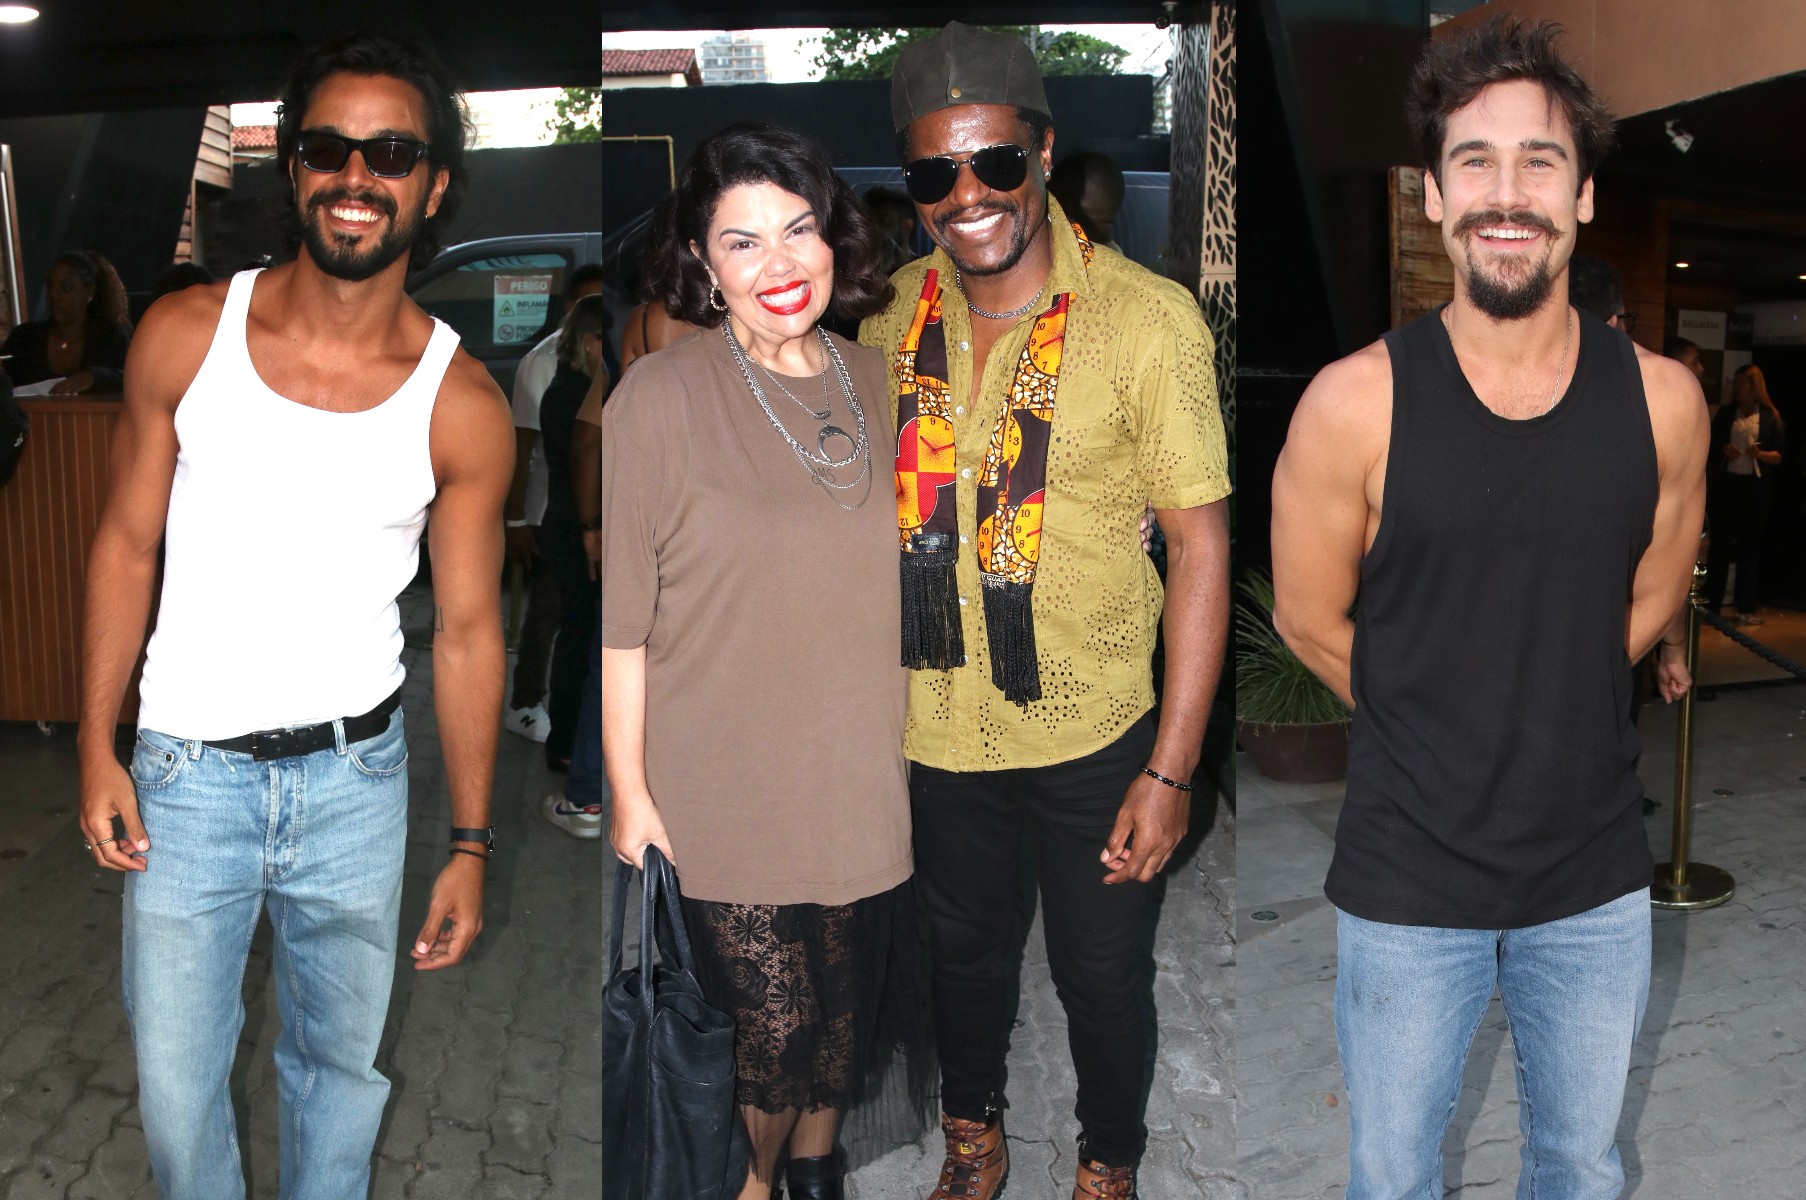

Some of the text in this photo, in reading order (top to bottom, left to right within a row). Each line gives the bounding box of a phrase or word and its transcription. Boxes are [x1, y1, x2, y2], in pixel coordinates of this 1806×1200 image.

[511, 281, 548, 291] PERIGO
[517, 299, 548, 308] INFLAMÁ
[1036, 322, 1046, 331] 10
[1030, 338, 1037, 346] 9
[1032, 352, 1039, 360] 8
[1042, 361, 1048, 370] 7
[1013, 436, 1020, 446] 3
[1020, 509, 1031, 518] 10
[981, 526, 990, 536] 10
[1015, 525, 1022, 534] 9
[979, 541, 985, 550] 9
[1018, 539, 1025, 549] 8
[1029, 550, 1036, 559] 7
[982, 556, 988, 566] 8
